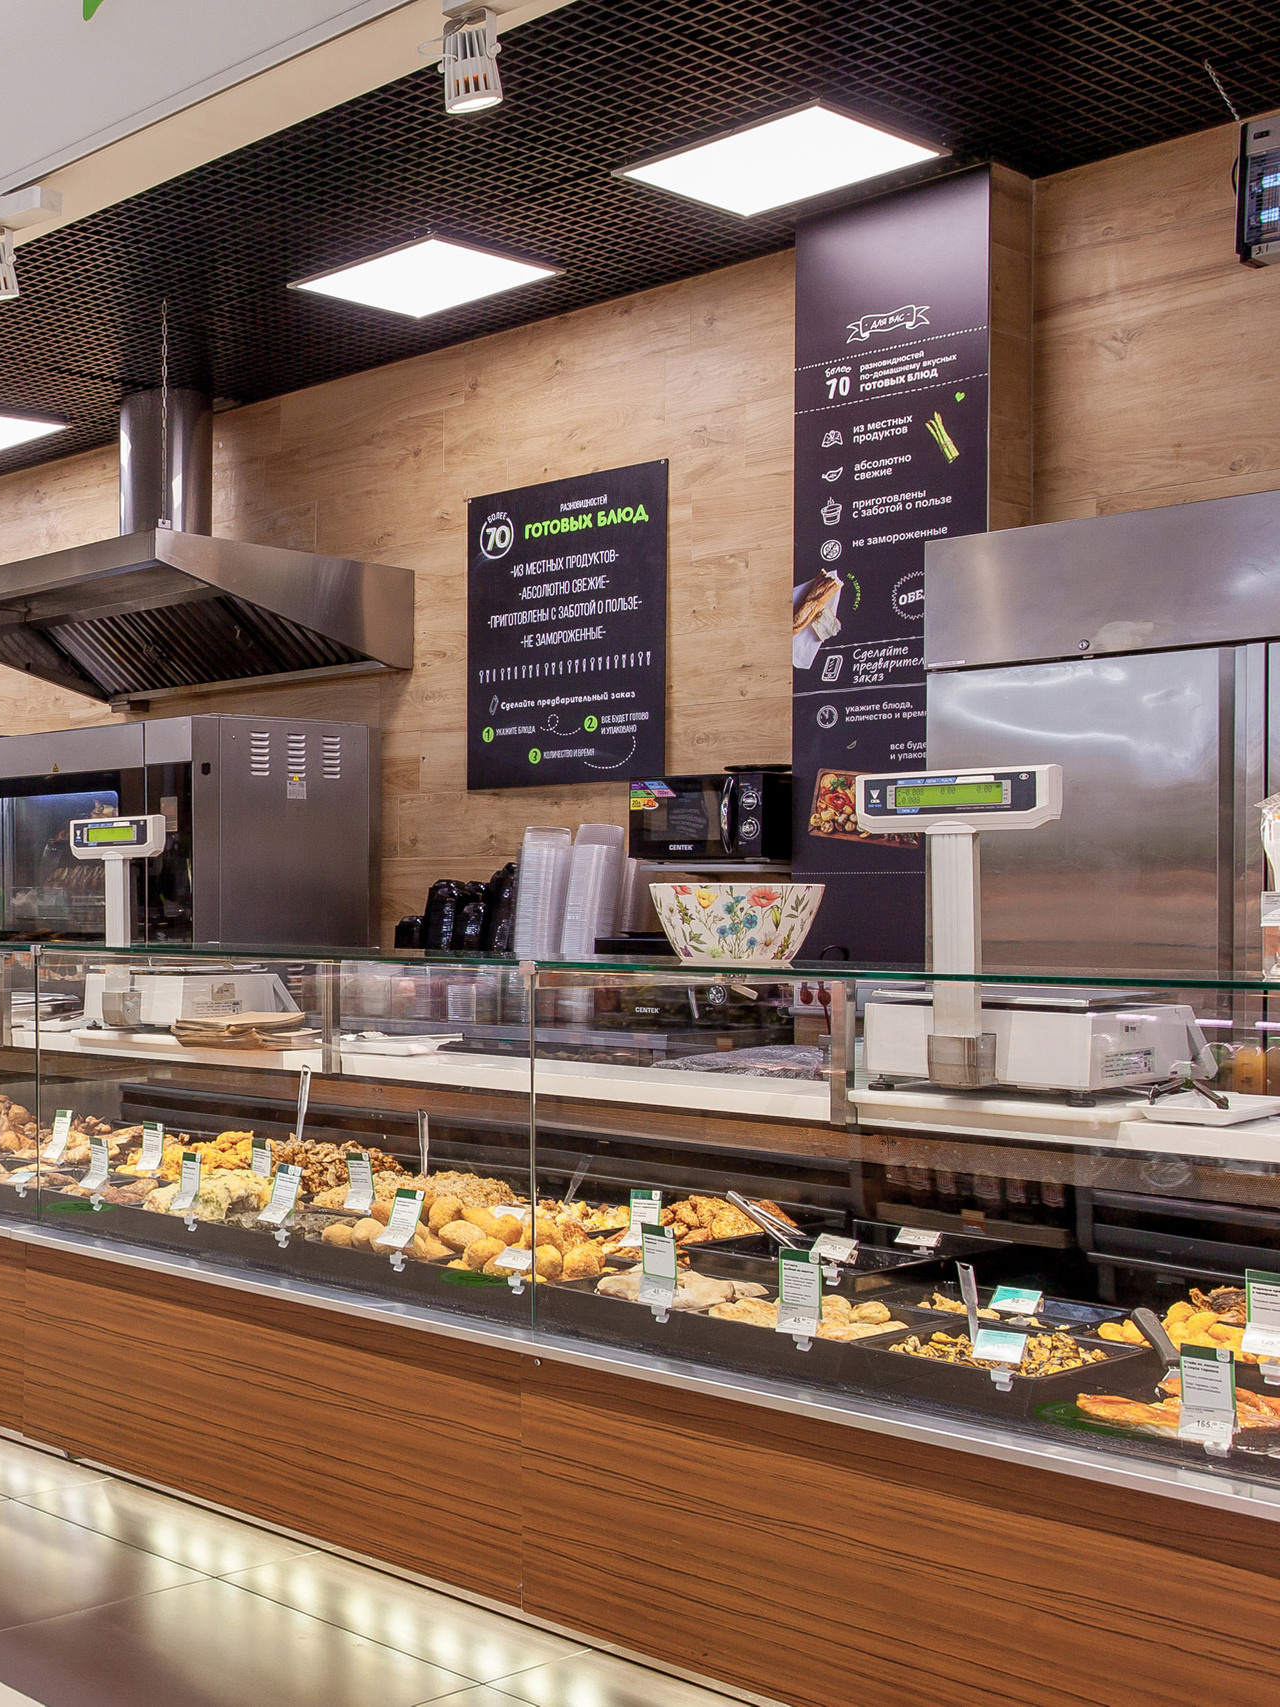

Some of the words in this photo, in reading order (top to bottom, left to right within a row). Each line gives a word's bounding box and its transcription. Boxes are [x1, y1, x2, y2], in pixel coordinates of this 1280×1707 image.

[870, 318, 887, 329] ДЛЯ
[888, 313, 905, 325] ВАС
[860, 350, 924, 372] разновидностей
[860, 362, 921, 381] по-домашнему
[922, 354, 957, 369] вкусных
[825, 365, 851, 378] более
[860, 375, 905, 392] ГОТОВЫХ
[907, 368, 938, 382] БЛЮД
[826, 376, 850, 400] 70
[853, 424, 865, 434] из
[867, 414, 913, 432] местных
[853, 426, 908, 445] продуктов
[854, 453, 912, 471] абсолютно
[854, 467, 893, 481] свежие
[560, 493, 608, 512] РАЗНОВИДНОСТЕЙ
[852, 490, 926, 511] приготовлены
[860, 500, 903, 517] заботой
[905, 502, 912, 510] о
[915, 495, 952, 509] пользе
[487, 511, 508, 524] БОЛЕЕ
[524, 513, 593, 540] ГОТОВЫХ
[597, 504, 649, 531] БЛЮД
[485, 525, 511, 551] 70
[852, 539, 865, 548] не
[867, 525, 948, 546] замороженные
[525, 556, 564, 575] МЕСТНЫХ
[899, 589, 925, 605] ОБЕ
[551, 606, 557, 620] С
[558, 600, 596, 620] ЗАБОТОЙ
[598, 601, 603, 615] О
[853, 645, 908, 662] Сделайте
[853, 673, 884, 683] заказ
[500, 698, 535, 711] Сделайте
[537, 691, 609, 708] предварительный
[611, 690, 636, 701] заказ
[845, 704, 880, 714] укажите
[882, 701, 913, 710] блюда,
[601, 714, 610, 724] ВСЕ
[612, 713, 628, 724] БУДЕТ
[629, 711, 649, 722] ГОТОВО
[845, 713, 892, 722] количество
[496, 726, 516, 736] УКАЖИТЕ
[518, 725, 536, 735] БЛЮДА
[601, 725, 605, 735] И
[606, 724, 638, 735] УПАКОВАНО
[543, 749, 572, 760] КОЛИЧЕСТВО
[578, 748, 595, 758] ВРЕМЯ
[635, 1006, 660, 1014] CENTEK
